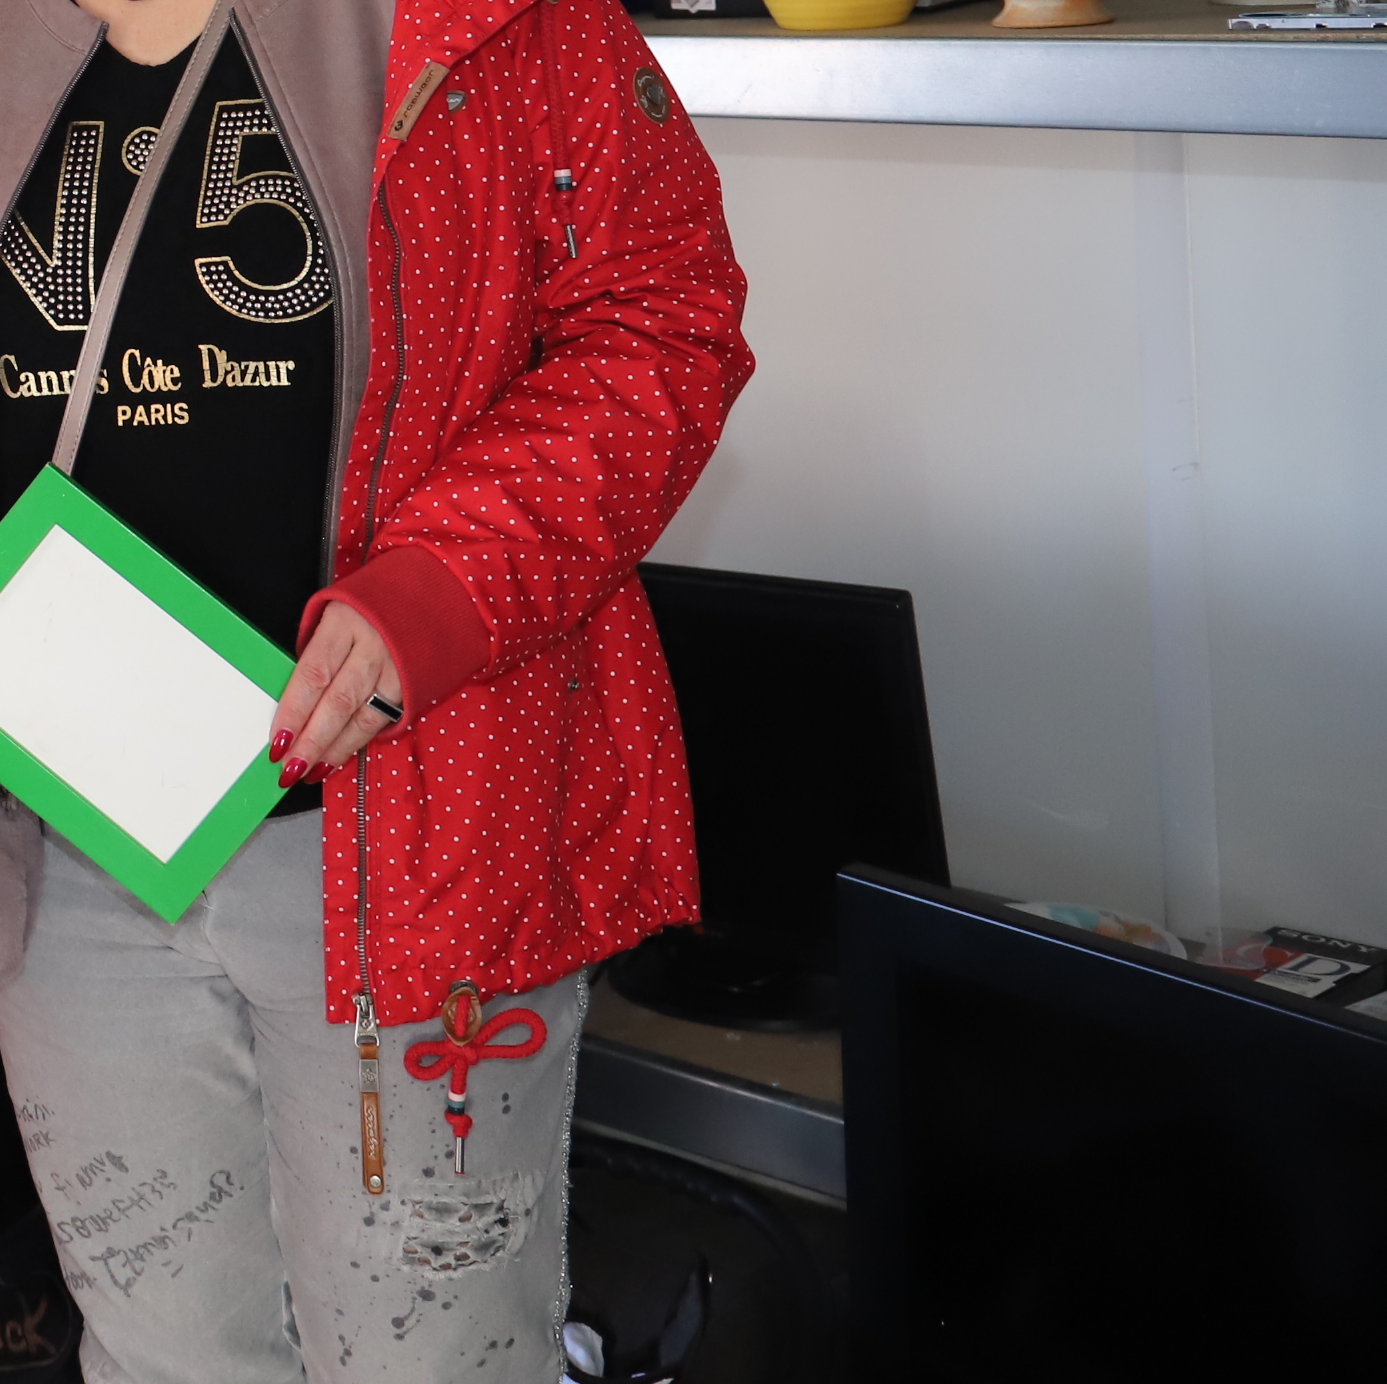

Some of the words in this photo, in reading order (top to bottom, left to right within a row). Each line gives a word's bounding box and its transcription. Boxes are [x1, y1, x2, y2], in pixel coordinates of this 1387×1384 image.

[122, 348, 182, 393] Côte
[117, 403, 189, 427] PARIS
[1277, 929, 1380, 952] SONY
